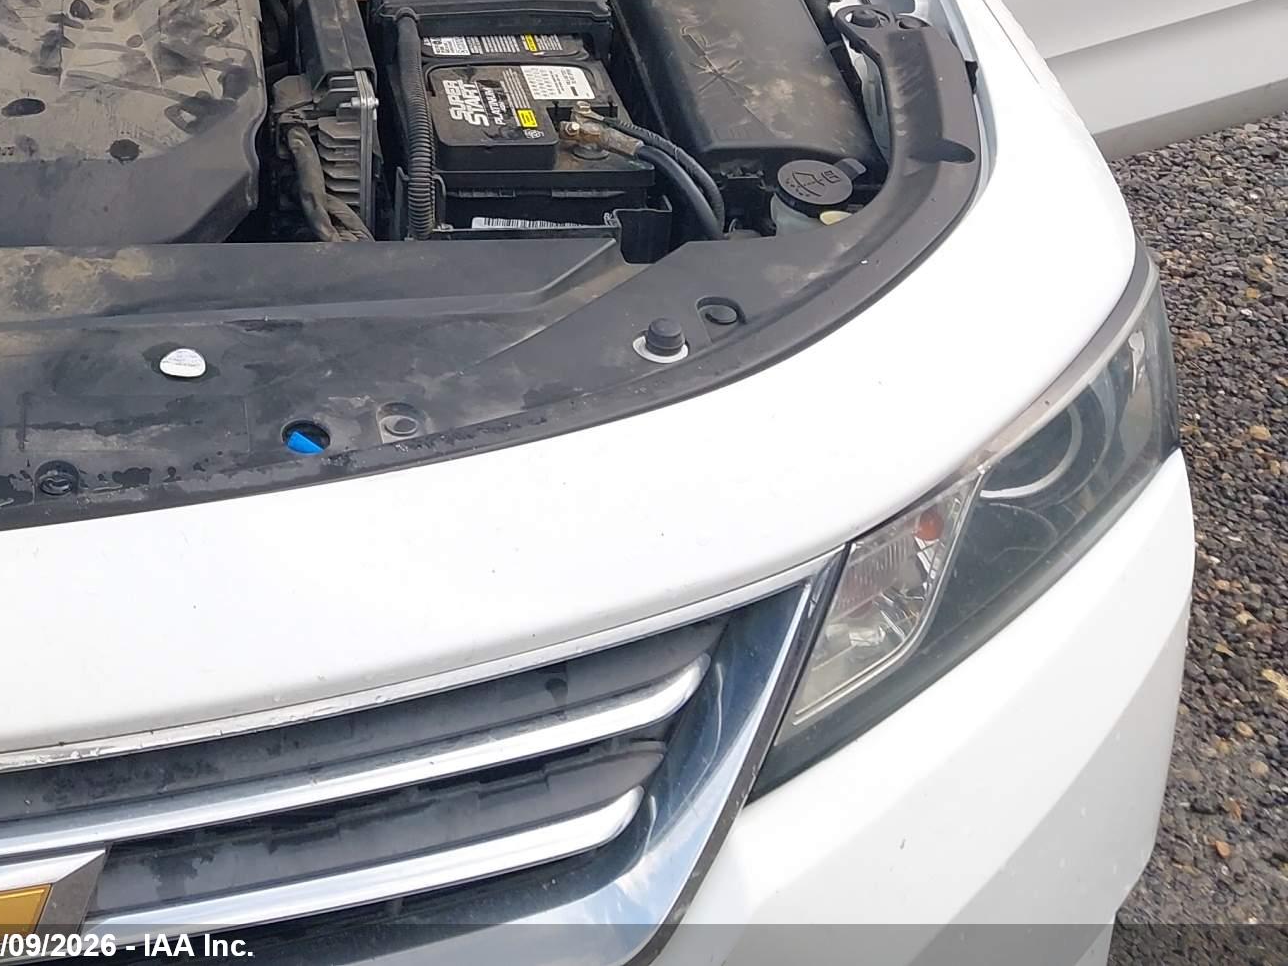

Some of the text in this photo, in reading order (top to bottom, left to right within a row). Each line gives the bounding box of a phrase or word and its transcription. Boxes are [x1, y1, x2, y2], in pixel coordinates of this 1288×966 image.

[442, 79, 464, 120] SUPER
[457, 80, 490, 126] START
[483, 86, 506, 125] PLATINUM
